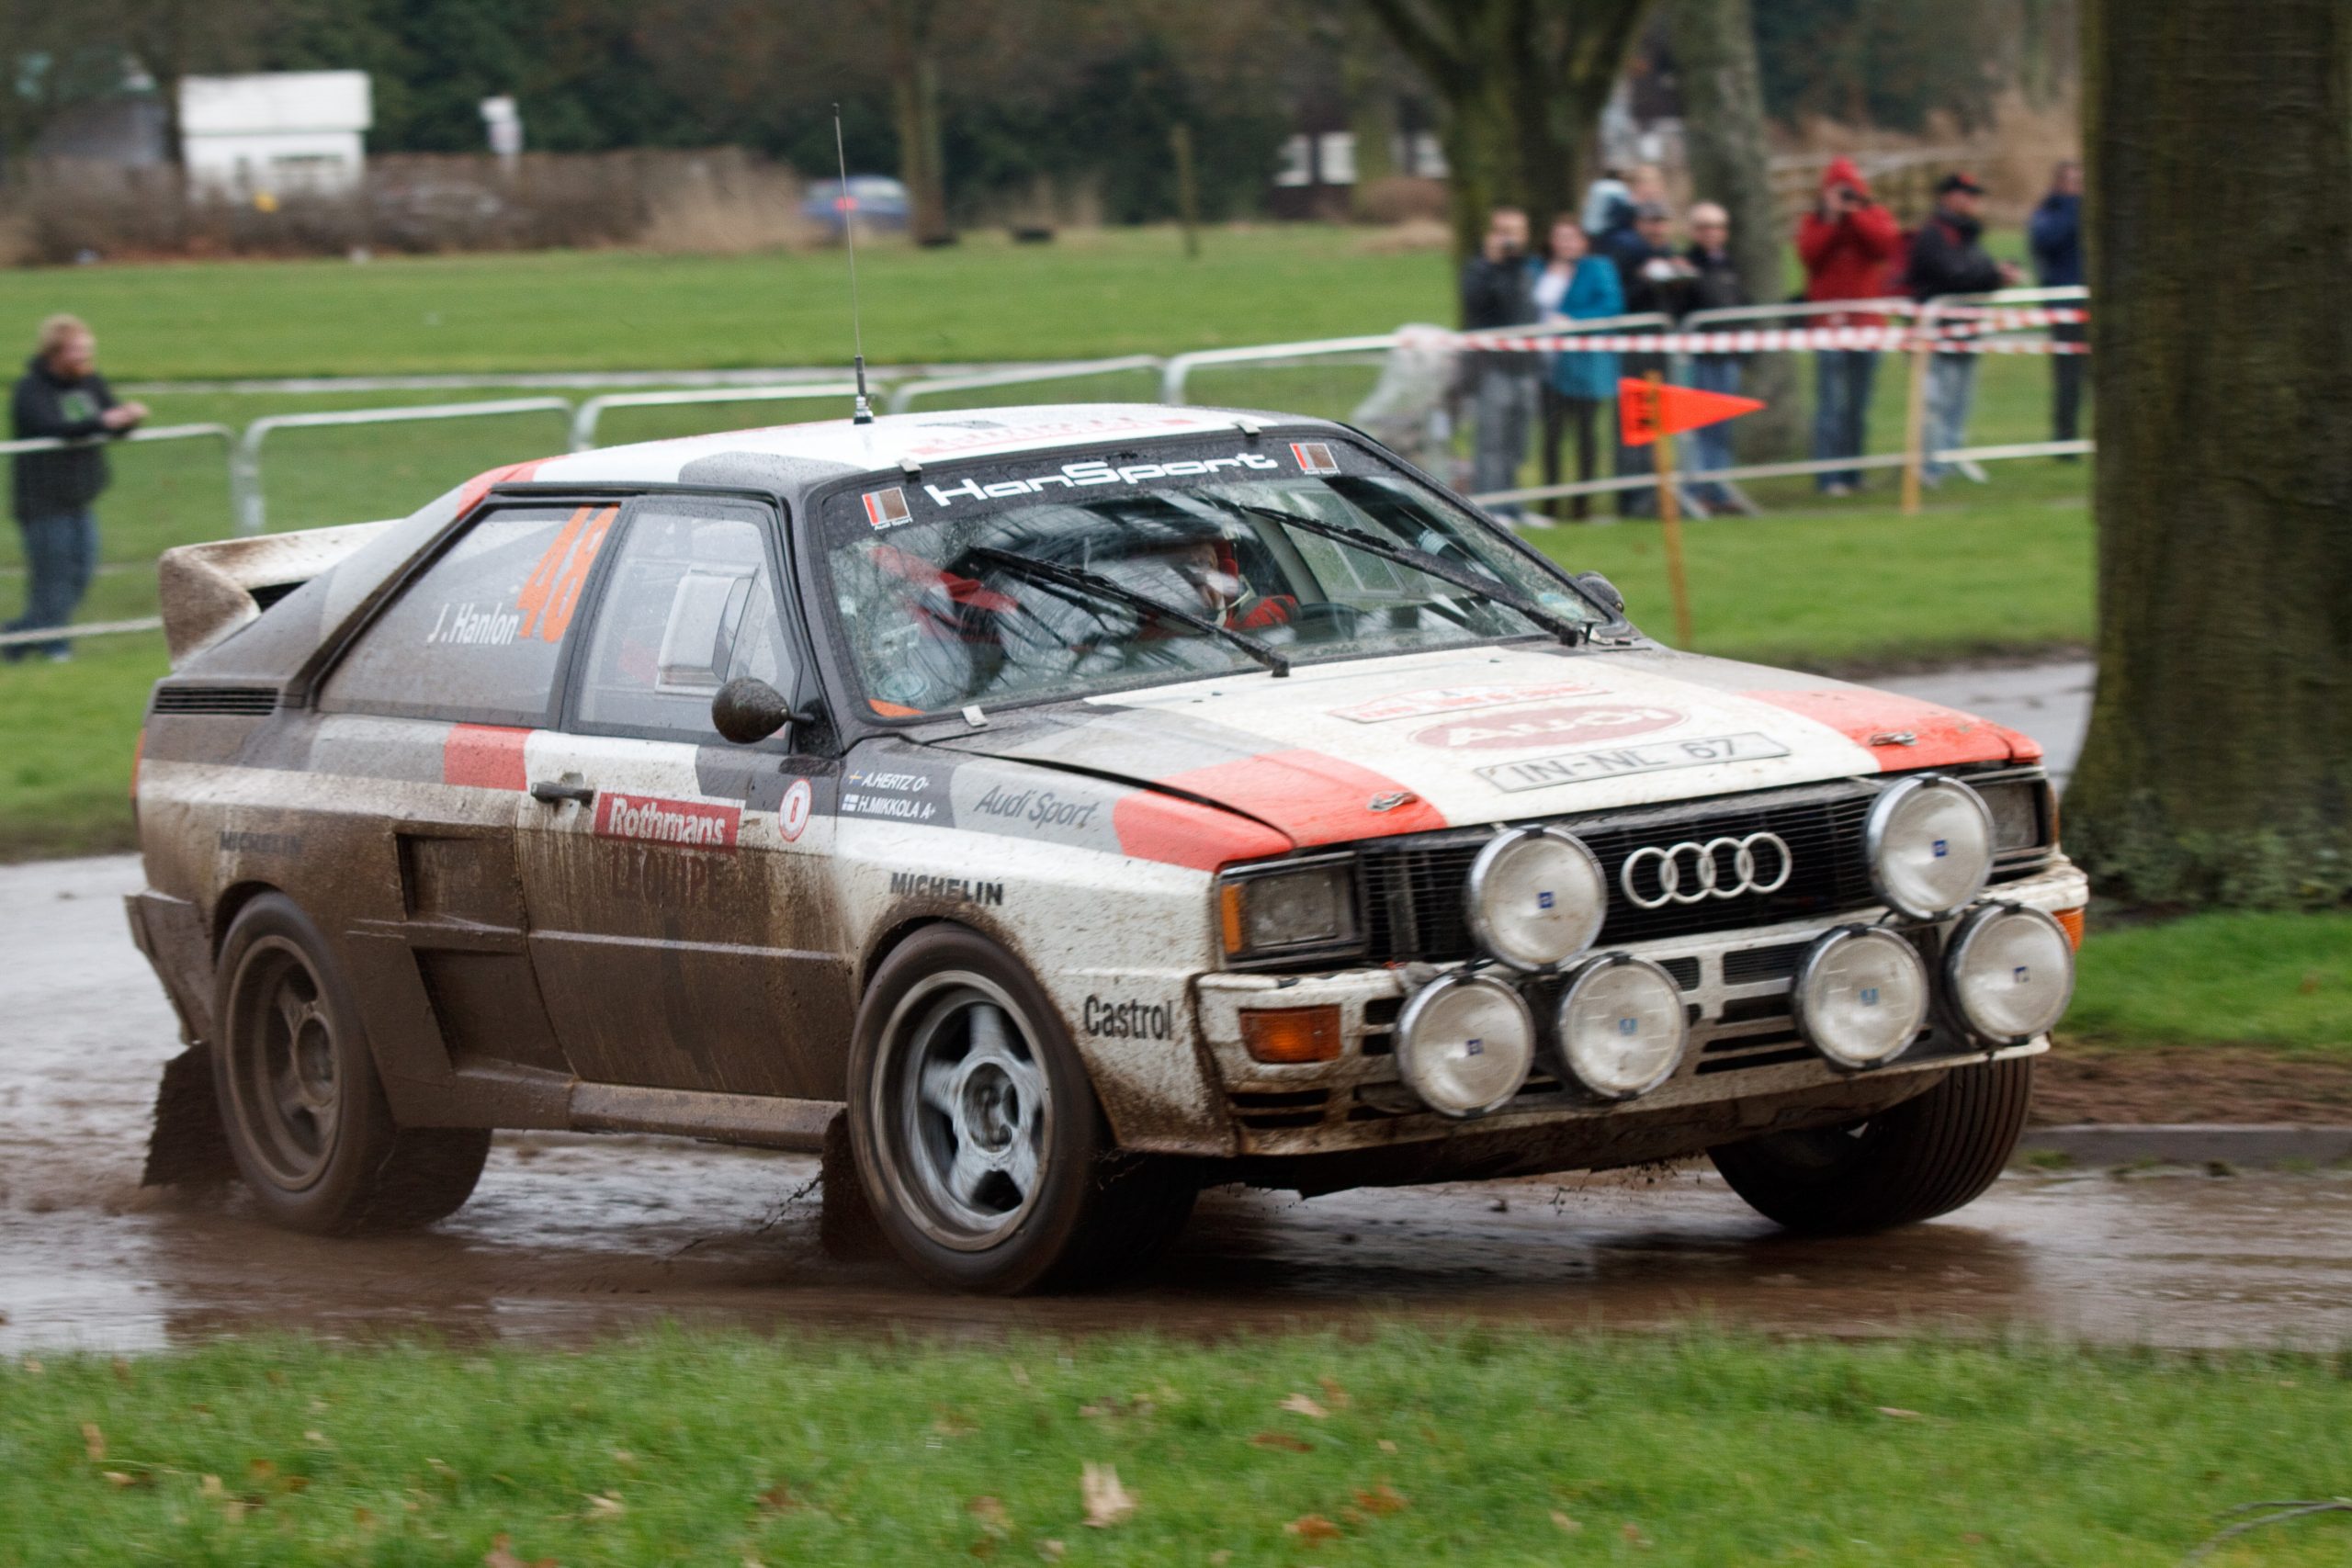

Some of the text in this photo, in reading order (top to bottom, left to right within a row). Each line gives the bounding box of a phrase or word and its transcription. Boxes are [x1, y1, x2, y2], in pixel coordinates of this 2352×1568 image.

[924, 453, 1278, 507] HanSport
[861, 772, 917, 791] A.HERTZ
[1510, 738, 1736, 783] IN-NL 67
[608, 796, 726, 845] Rothmans
[856, 795, 922, 818] H.MIKKOLA
[973, 784, 1101, 830] Audi Sport
[889, 872, 1004, 906] MICHELIN
[1084, 993, 1172, 1041] Castrol
